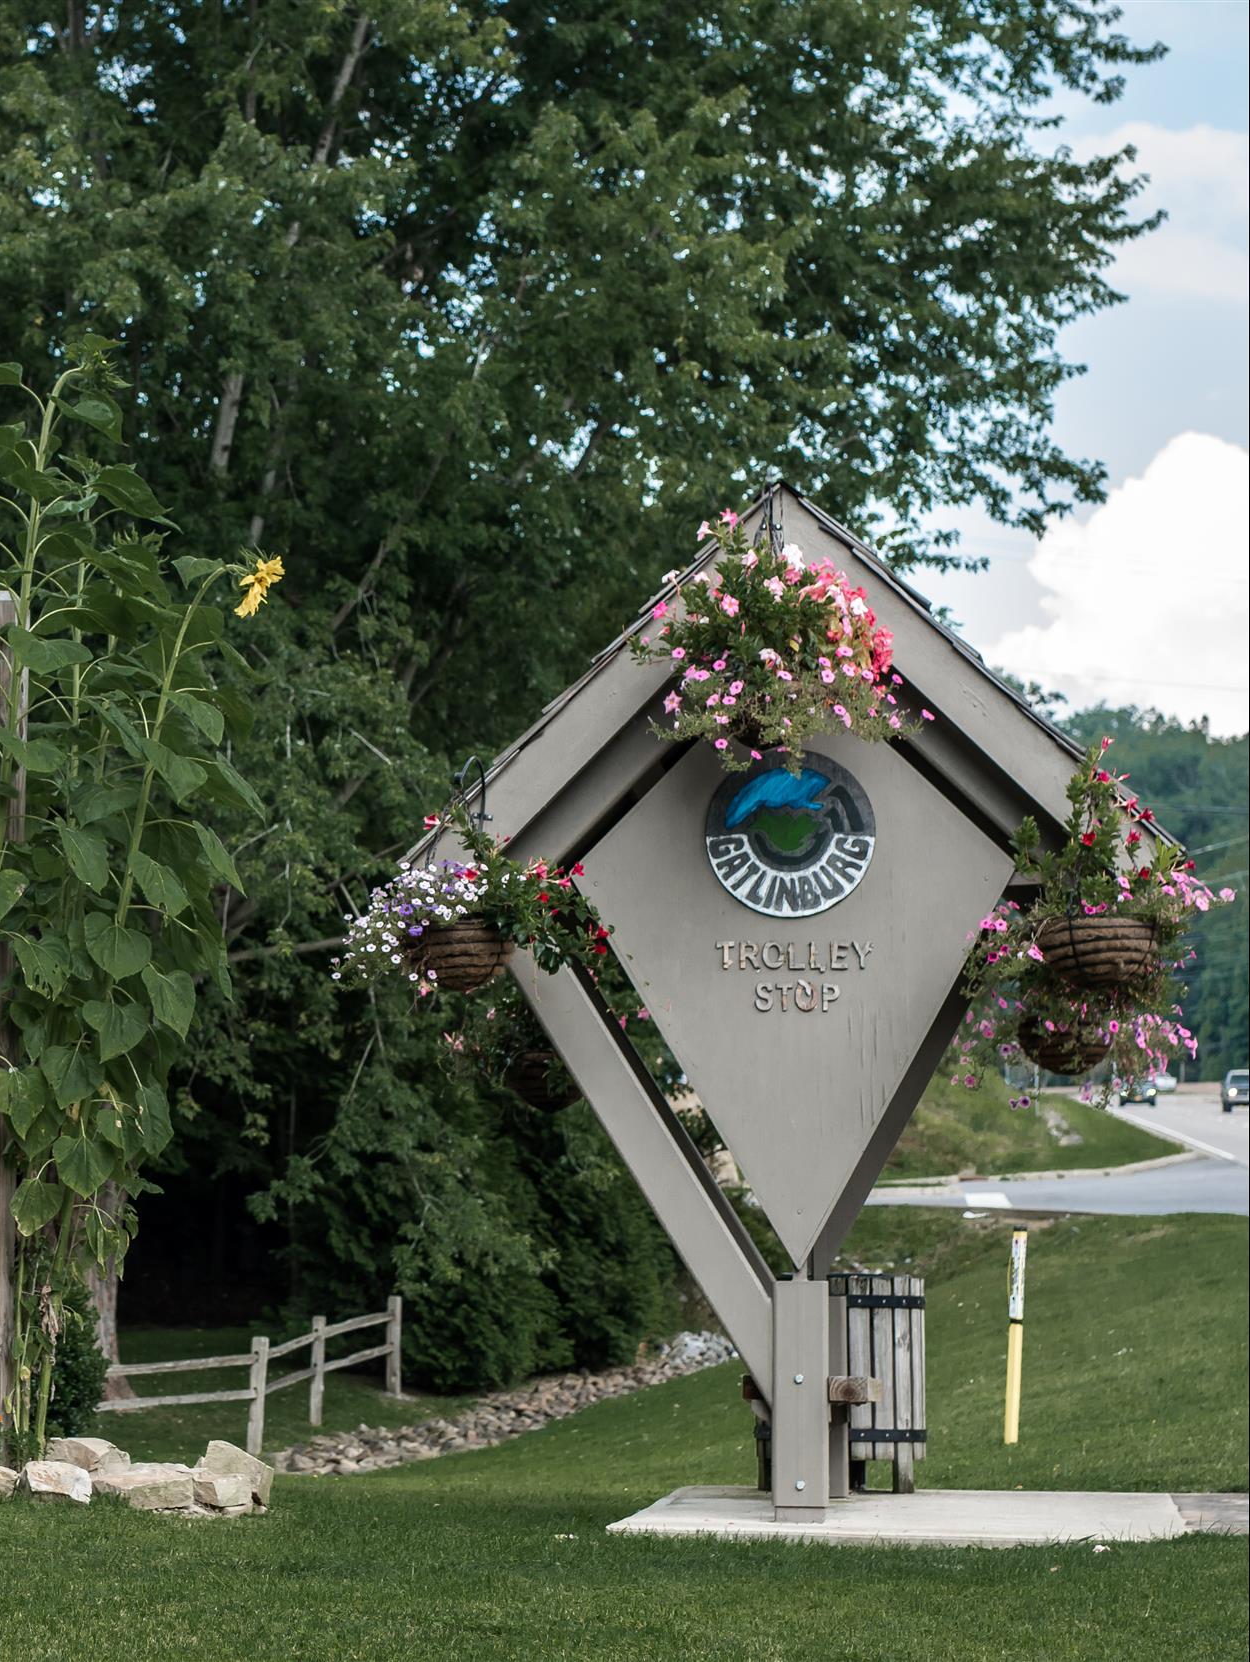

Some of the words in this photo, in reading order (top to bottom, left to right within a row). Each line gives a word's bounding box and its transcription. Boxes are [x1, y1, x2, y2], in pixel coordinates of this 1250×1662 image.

[707, 835, 872, 912] GATLINBURG
[715, 940, 875, 973] TROLLEY
[754, 978, 841, 1013] STOP
